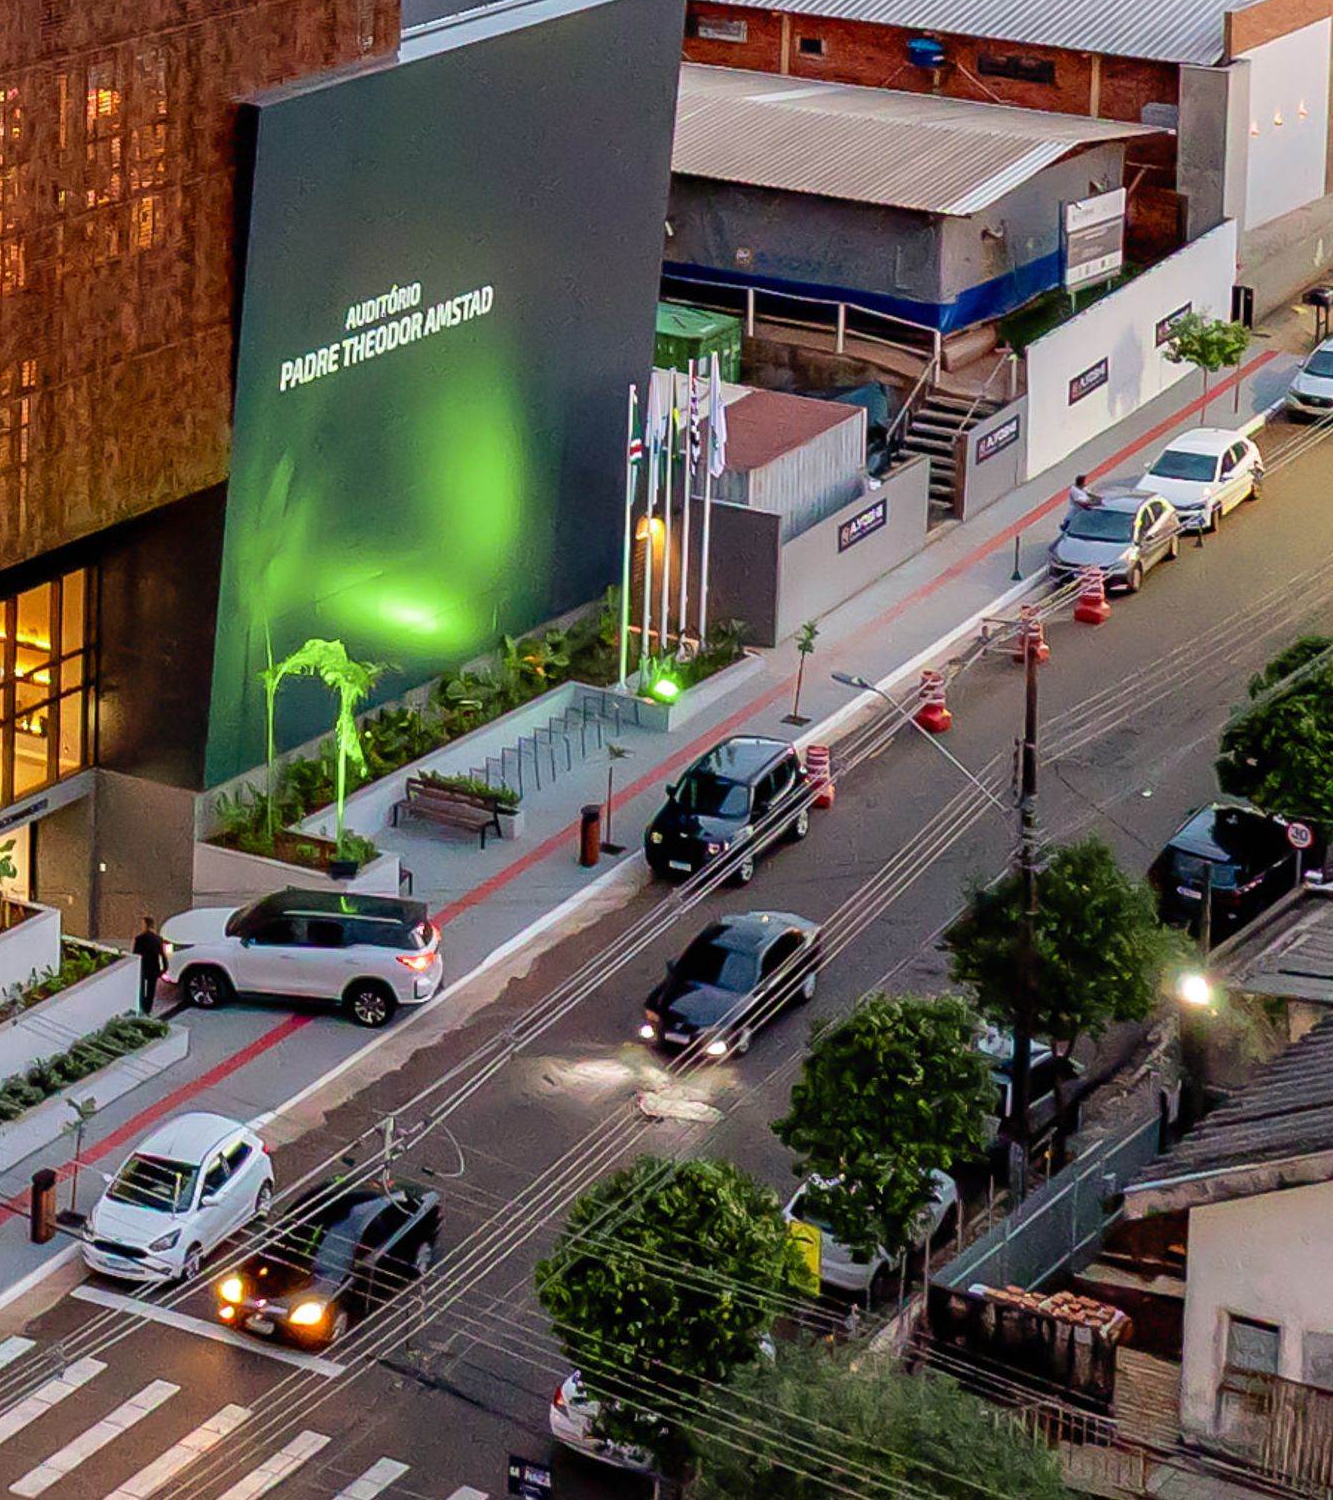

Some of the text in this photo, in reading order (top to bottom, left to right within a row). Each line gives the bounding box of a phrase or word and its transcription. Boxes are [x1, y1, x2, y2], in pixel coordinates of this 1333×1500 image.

[344, 282, 422, 331] AUDITÓRIO
[279, 285, 494, 392] PADRE THEODOR AMSTAD
[1290, 826, 1309, 842] 30
